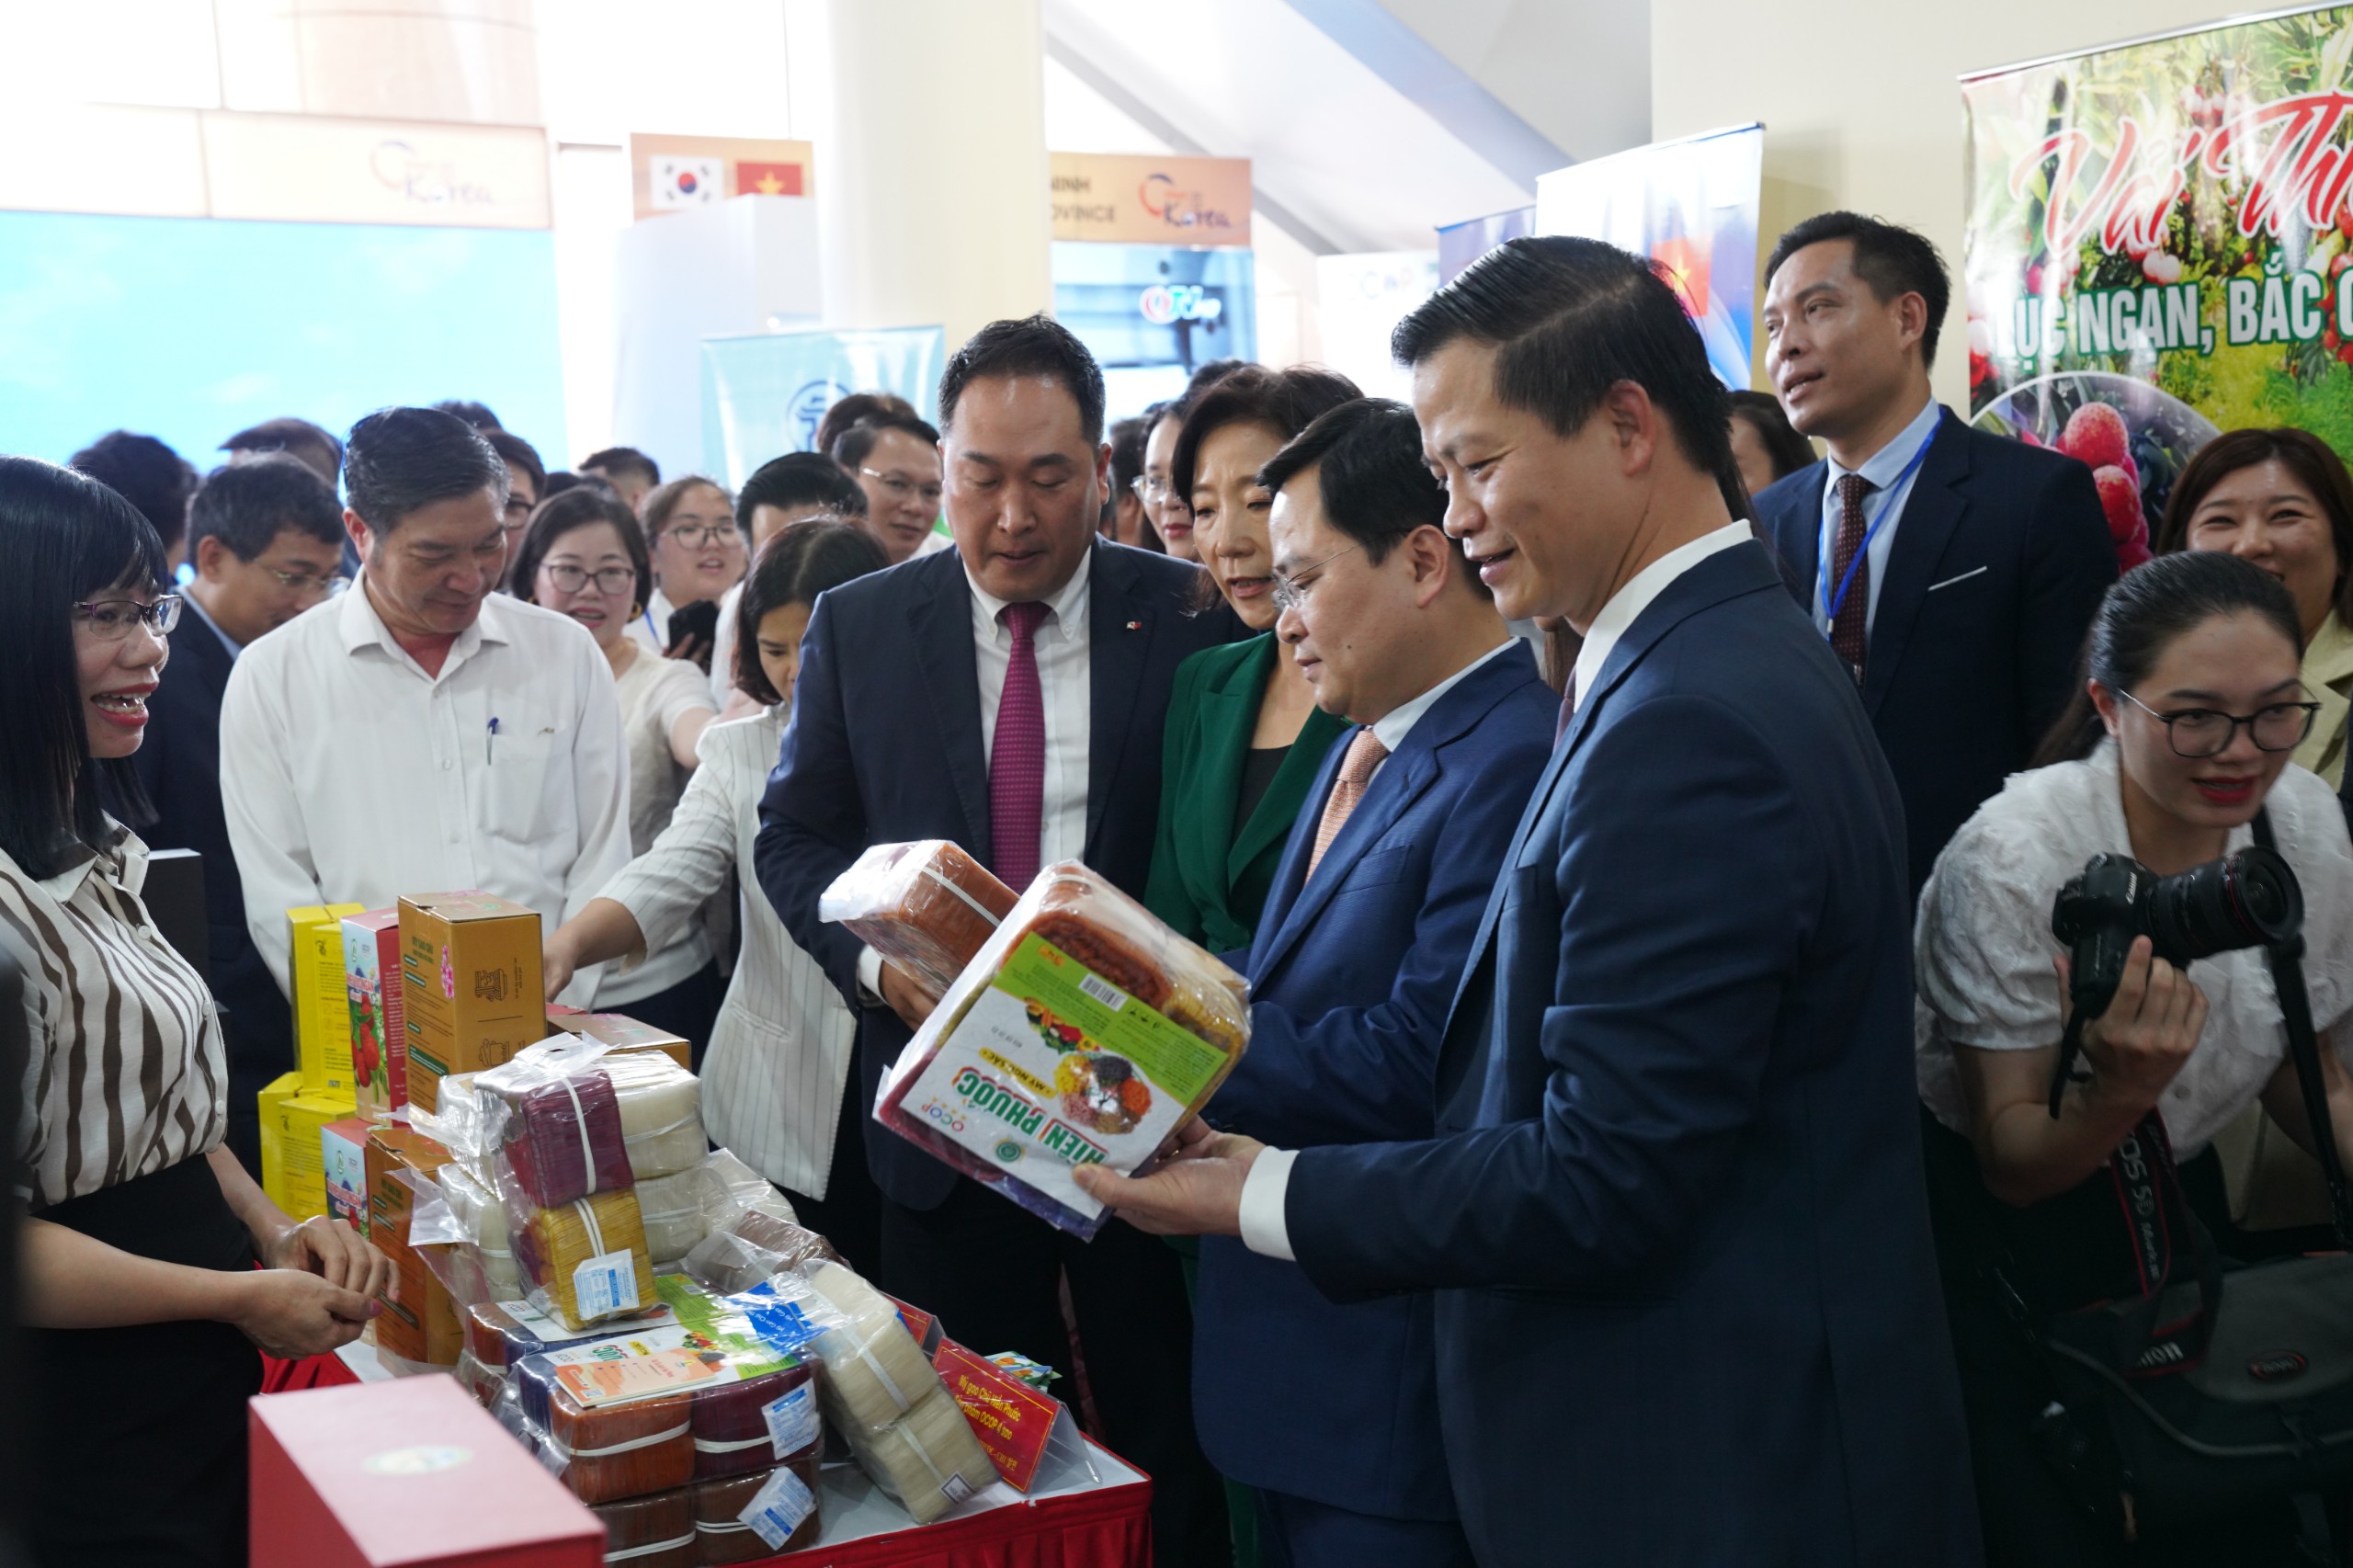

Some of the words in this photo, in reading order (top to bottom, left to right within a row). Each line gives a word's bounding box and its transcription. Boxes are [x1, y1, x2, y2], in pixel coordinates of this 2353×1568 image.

[2229, 251, 2322, 344] BẮC
[921, 1103, 964, 1132] OCOP
[956, 1072, 1044, 1136] PHƯỚC
[2137, 1332, 2184, 1368] non
[980, 1411, 998, 1429] OCOP
[996, 1422, 1004, 1434] 4
